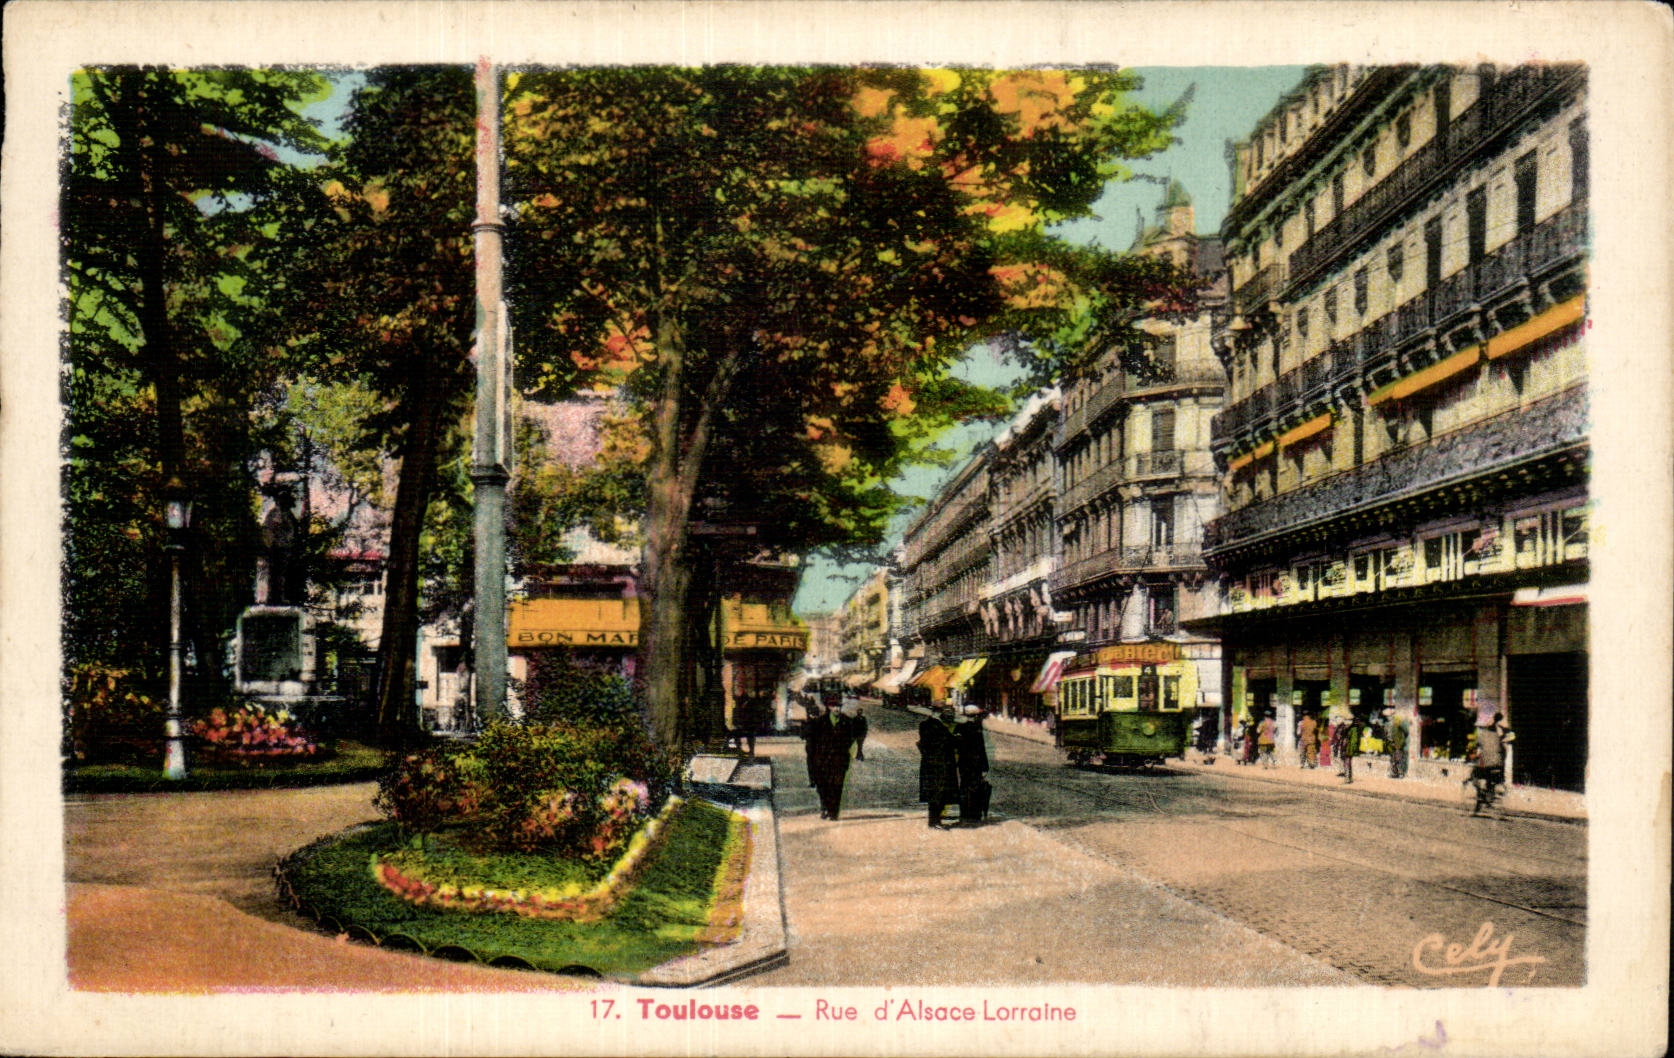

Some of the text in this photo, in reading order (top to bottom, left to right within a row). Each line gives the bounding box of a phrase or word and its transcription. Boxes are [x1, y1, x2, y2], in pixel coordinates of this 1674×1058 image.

[518, 631, 573, 643] BON
[755, 633, 806, 648] PARIS
[1144, 666, 1152, 675] 4
